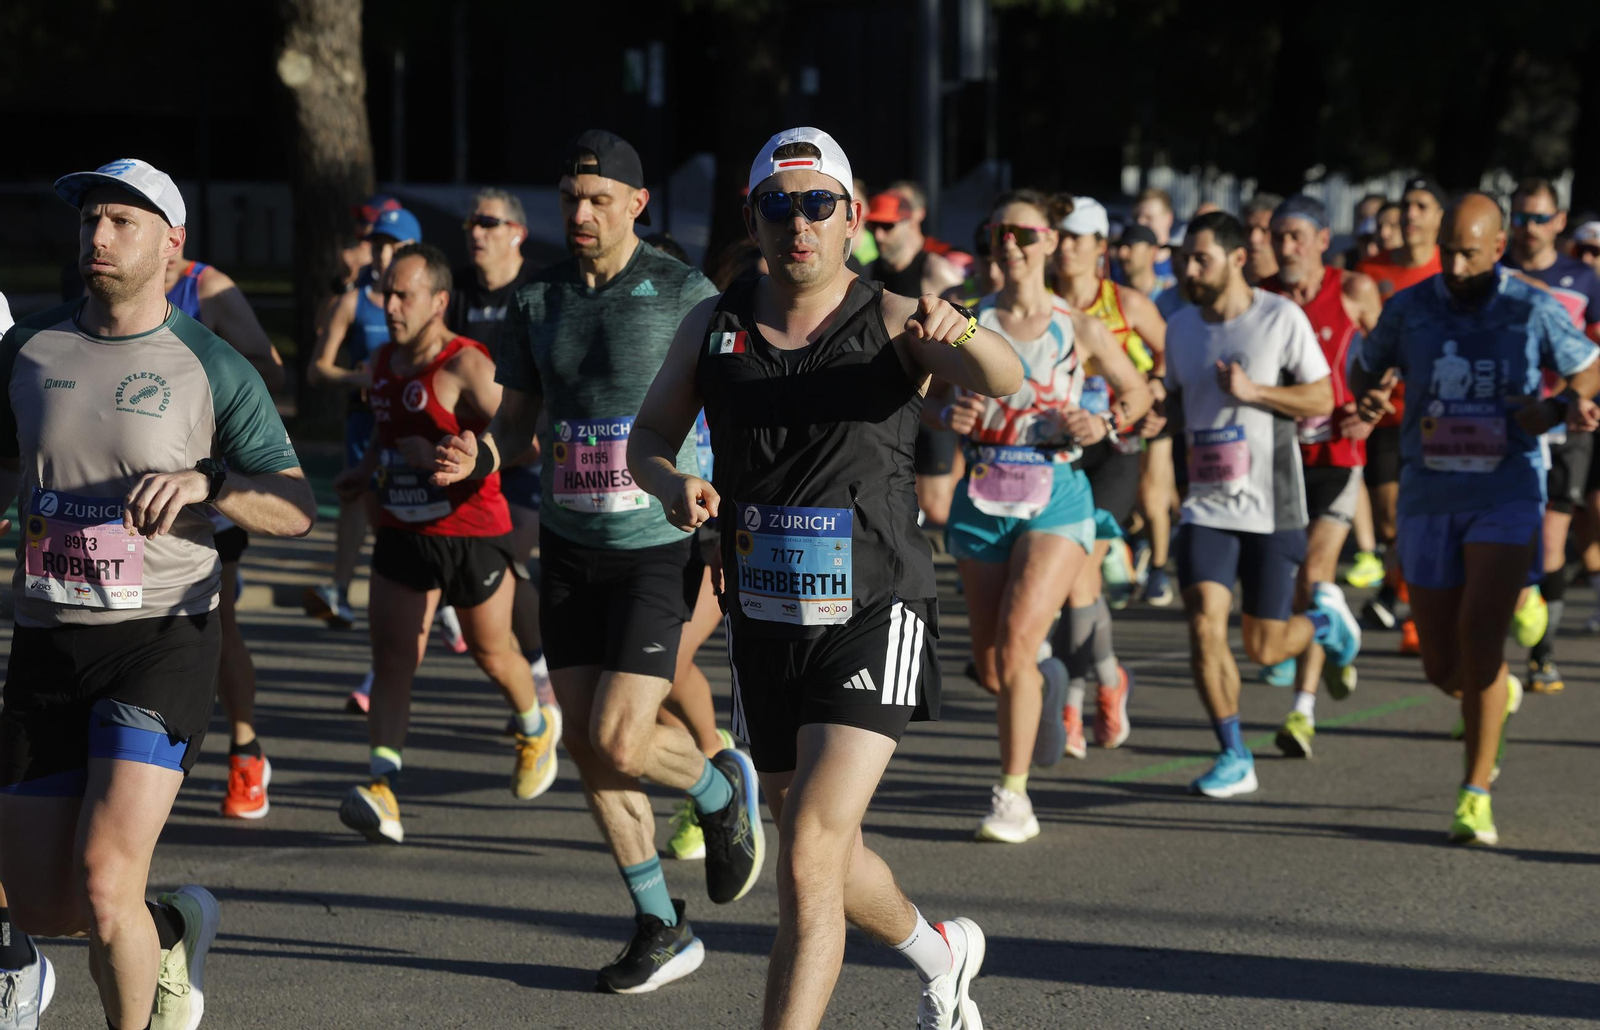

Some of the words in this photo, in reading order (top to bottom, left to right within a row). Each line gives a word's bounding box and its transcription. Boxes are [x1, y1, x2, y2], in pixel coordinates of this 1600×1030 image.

[115, 372, 166, 405] TRIATLETES
[577, 422, 631, 437] ZURICH
[581, 452, 608, 465] 8155
[564, 469, 633, 489] HANNES
[388, 488, 428, 504] DAVID
[769, 514, 836, 531] ZURICH
[64, 535, 97, 551] 8973
[770, 547, 804, 565] 7177
[42, 551, 125, 580] ROBERT
[741, 565, 847, 596] HERBERTH
